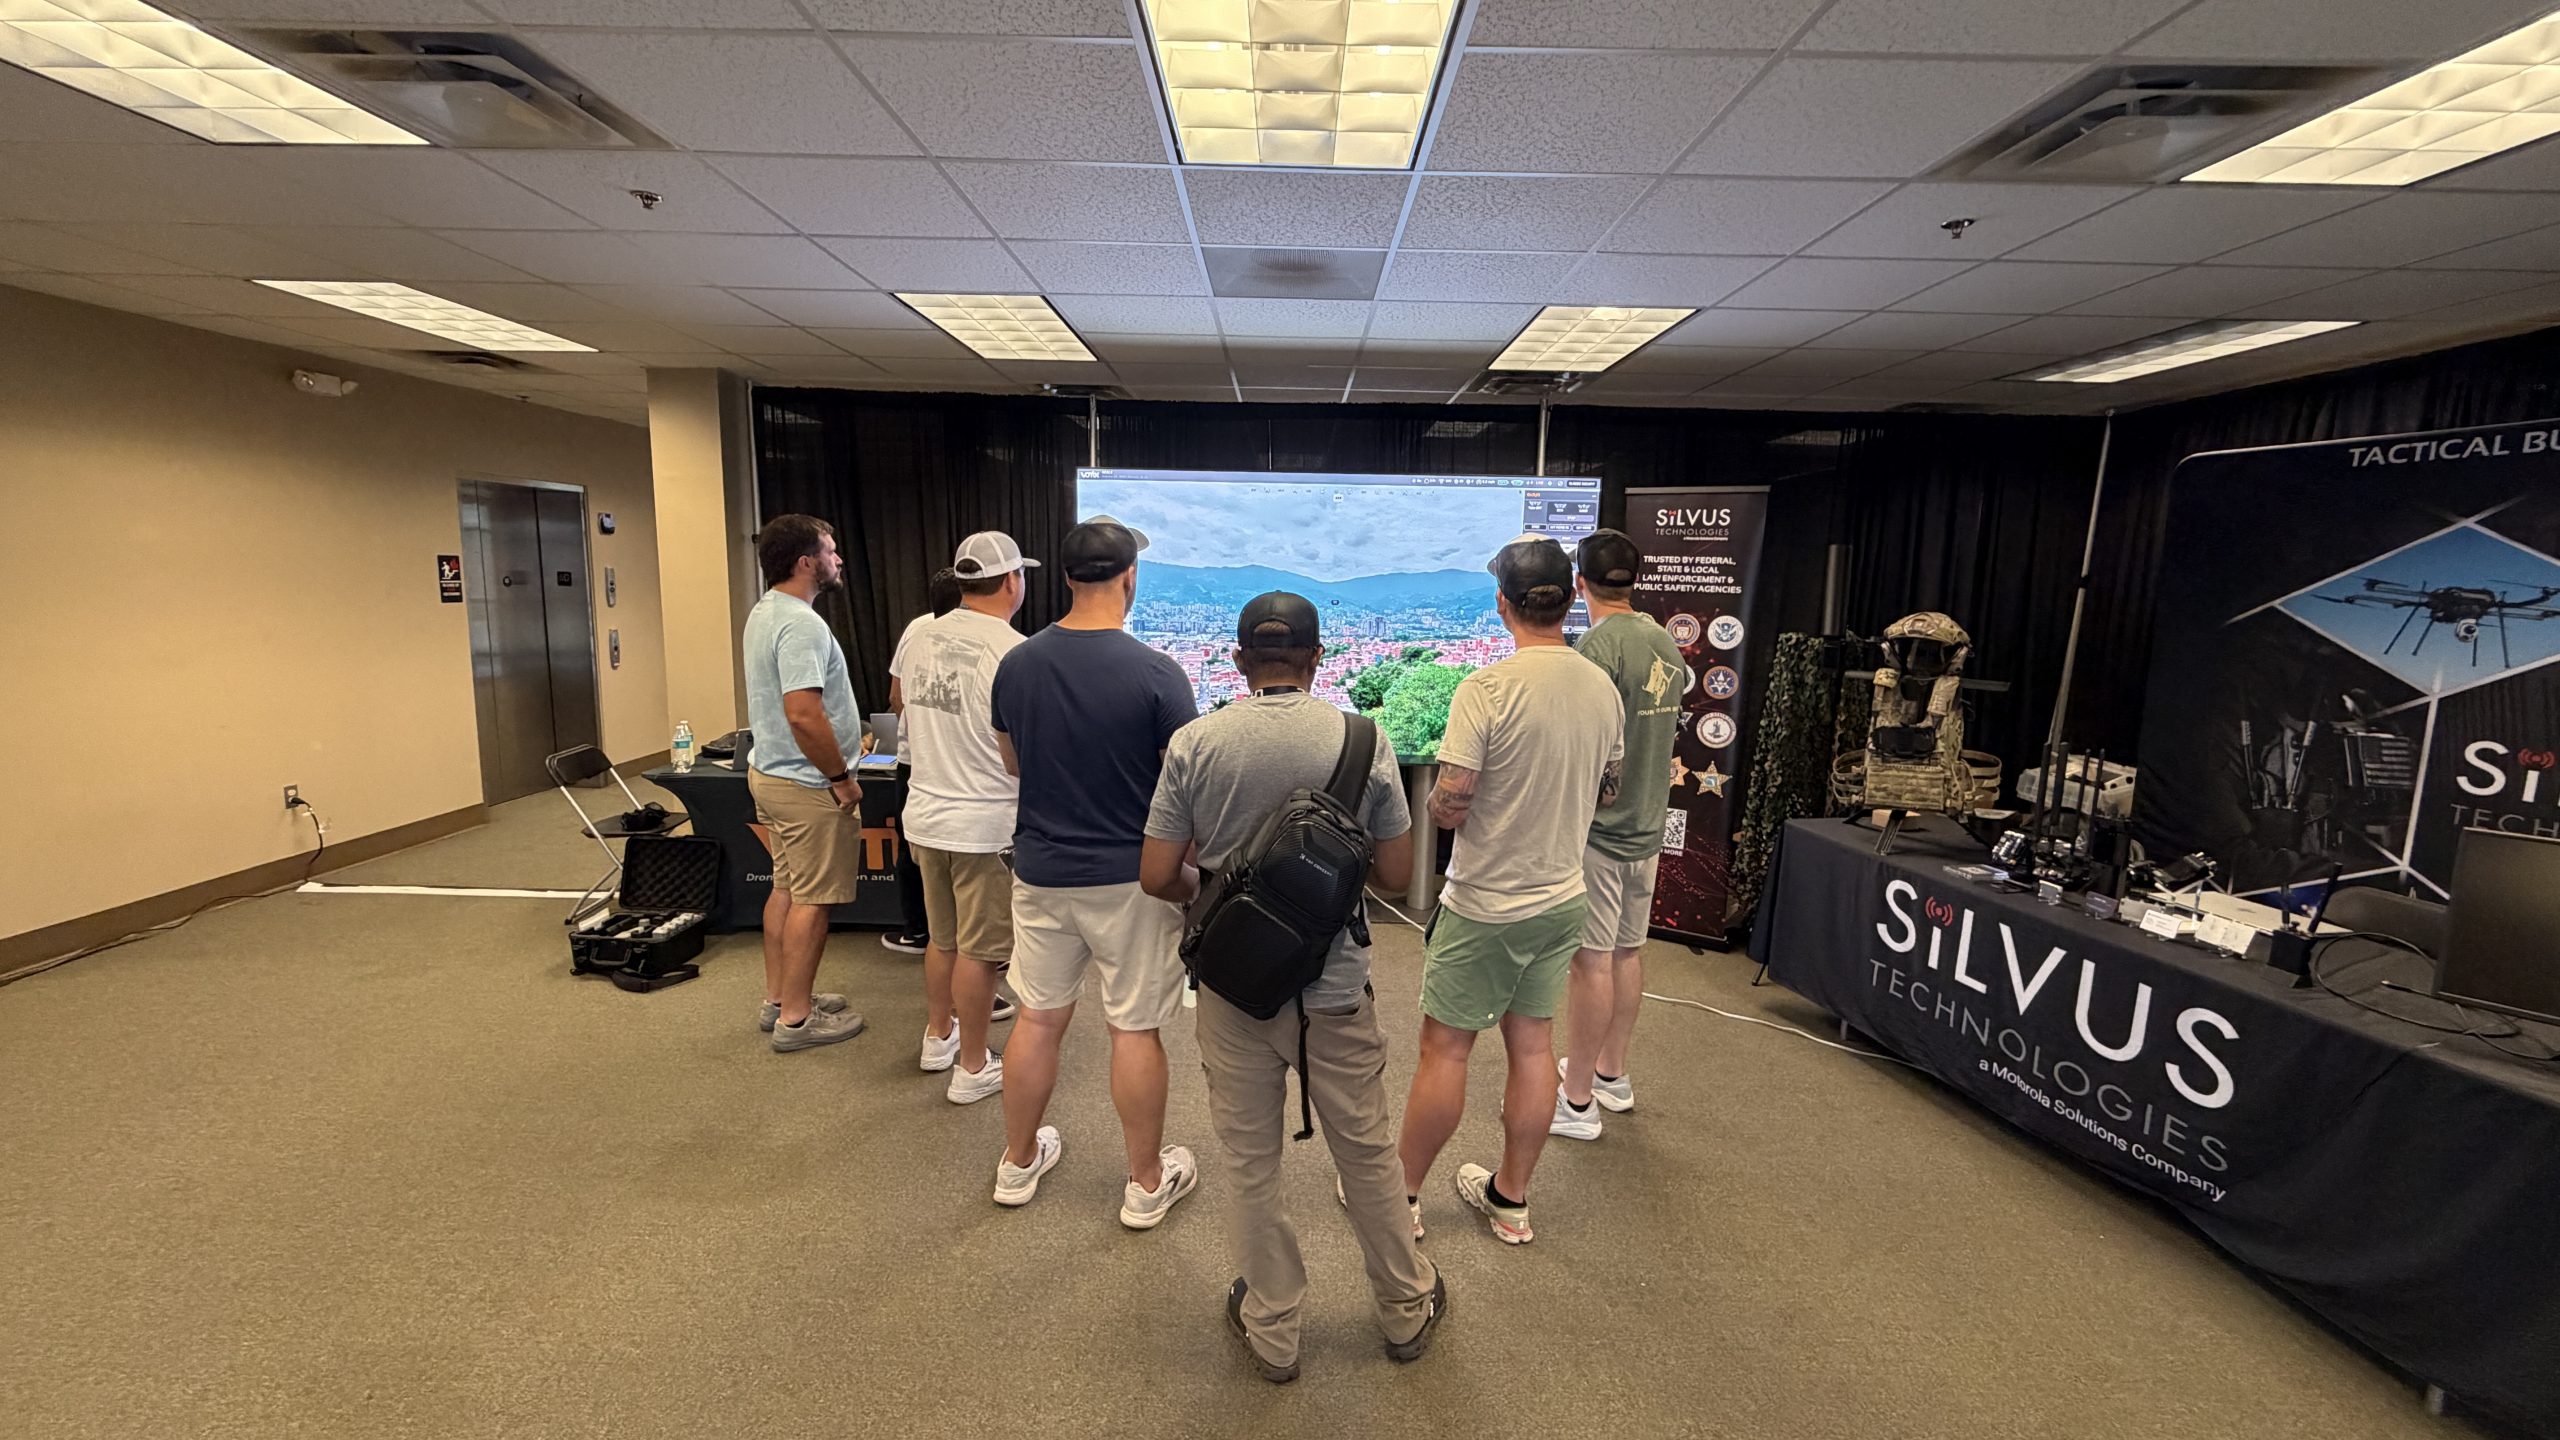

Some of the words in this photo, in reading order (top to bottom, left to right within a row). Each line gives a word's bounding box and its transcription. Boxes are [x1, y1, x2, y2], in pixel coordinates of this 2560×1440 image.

[2348, 434, 2510, 467] TACTICAL
[1656, 528, 1729, 536] TECHNOLOGIES
[1643, 555, 1681, 564] TRUSTED
[1682, 556, 1694, 564] BY
[1695, 556, 1737, 566] FEDERAL,
[1657, 565, 1682, 573] STATE
[1691, 566, 1719, 574] LOCAL
[1642, 574, 1662, 582] LAW
[1662, 575, 1726, 584] ENFORCEMENT
[1727, 576, 1735, 584] &
[1633, 583, 1663, 591] PUBLIC
[1664, 584, 1697, 592] SAFETY
[1698, 585, 1742, 594] AGENCIES
[745, 873, 773, 882] Dron
[871, 873, 895, 882] and
[1868, 958, 2228, 1172] TECHNOLOGIES
[1978, 1059, 1989, 1071] a
[1992, 1062, 2051, 1109] Motorola
[2054, 1099, 2128, 1152] Solutions
[2131, 1143, 2226, 1203] Company
